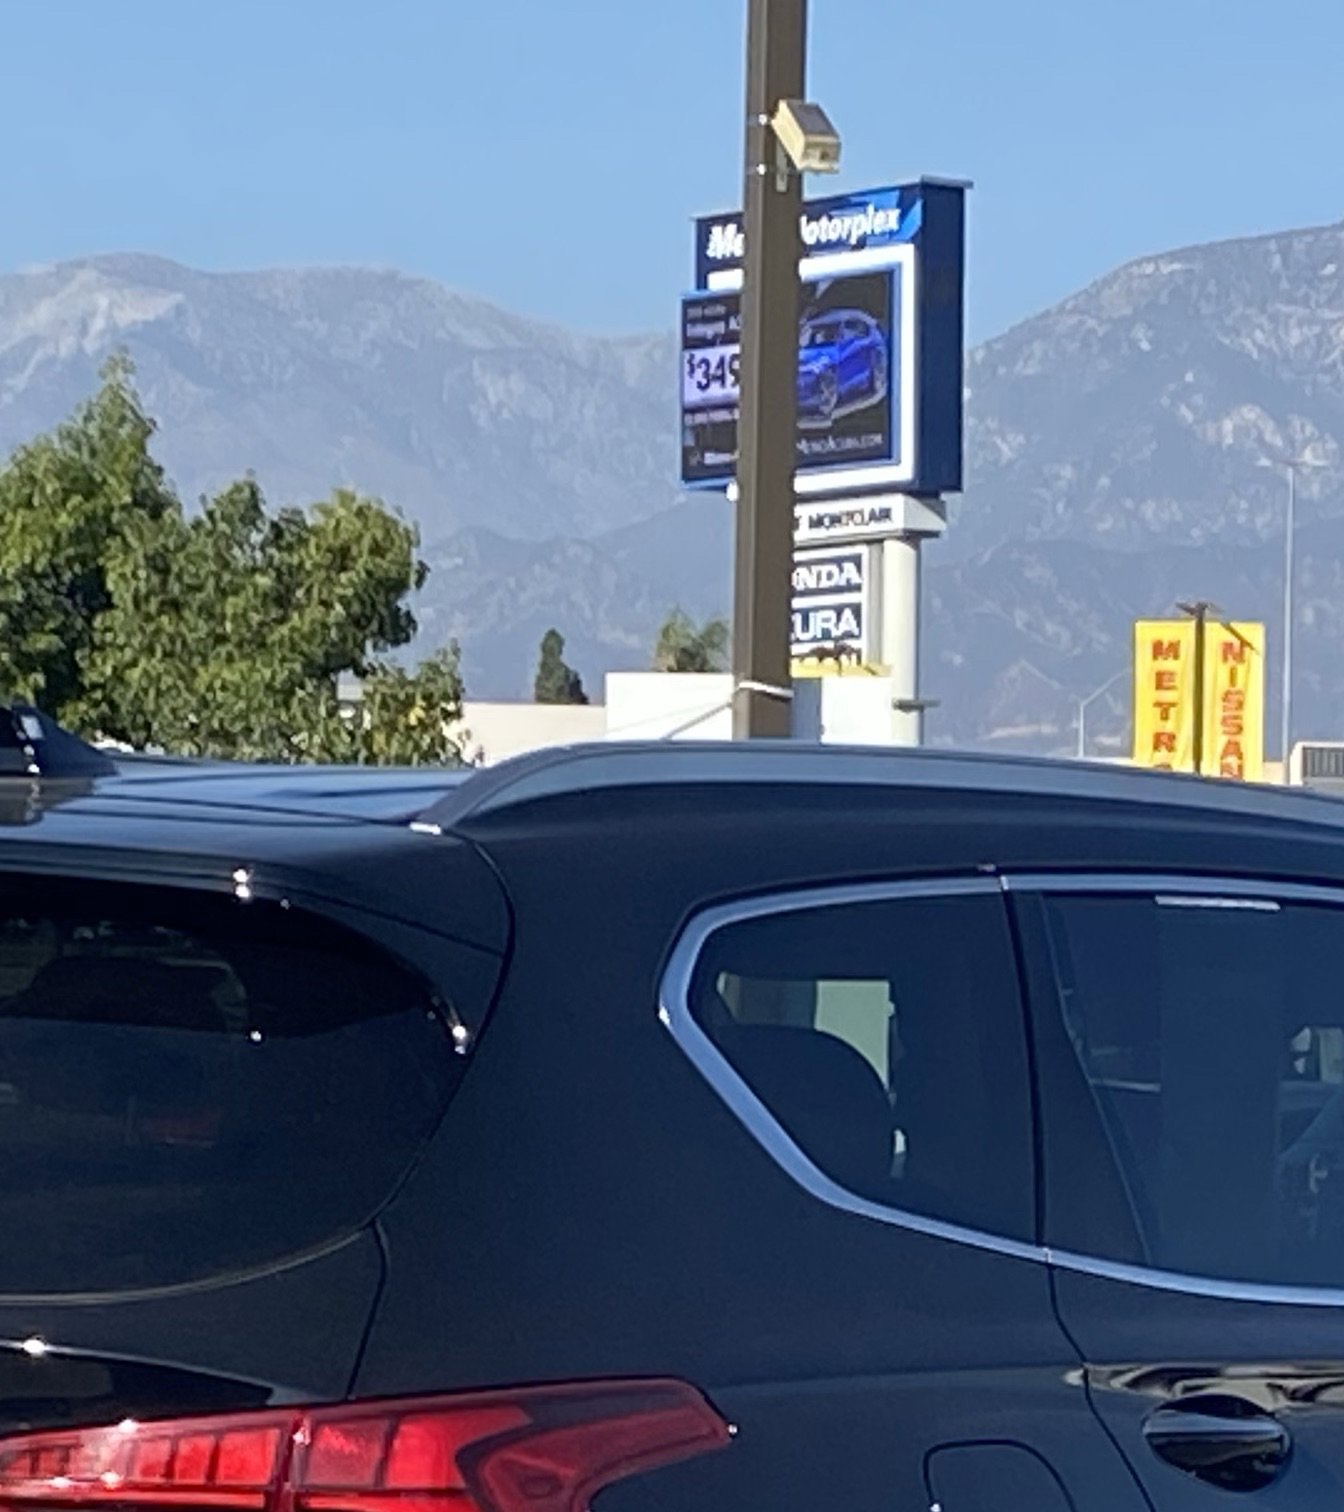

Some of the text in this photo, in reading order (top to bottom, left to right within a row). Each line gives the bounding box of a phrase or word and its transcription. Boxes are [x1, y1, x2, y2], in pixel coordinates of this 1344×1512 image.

[799, 202, 901, 247] otorplex
[792, 560, 862, 591] NDA
[790, 607, 861, 642] URA
